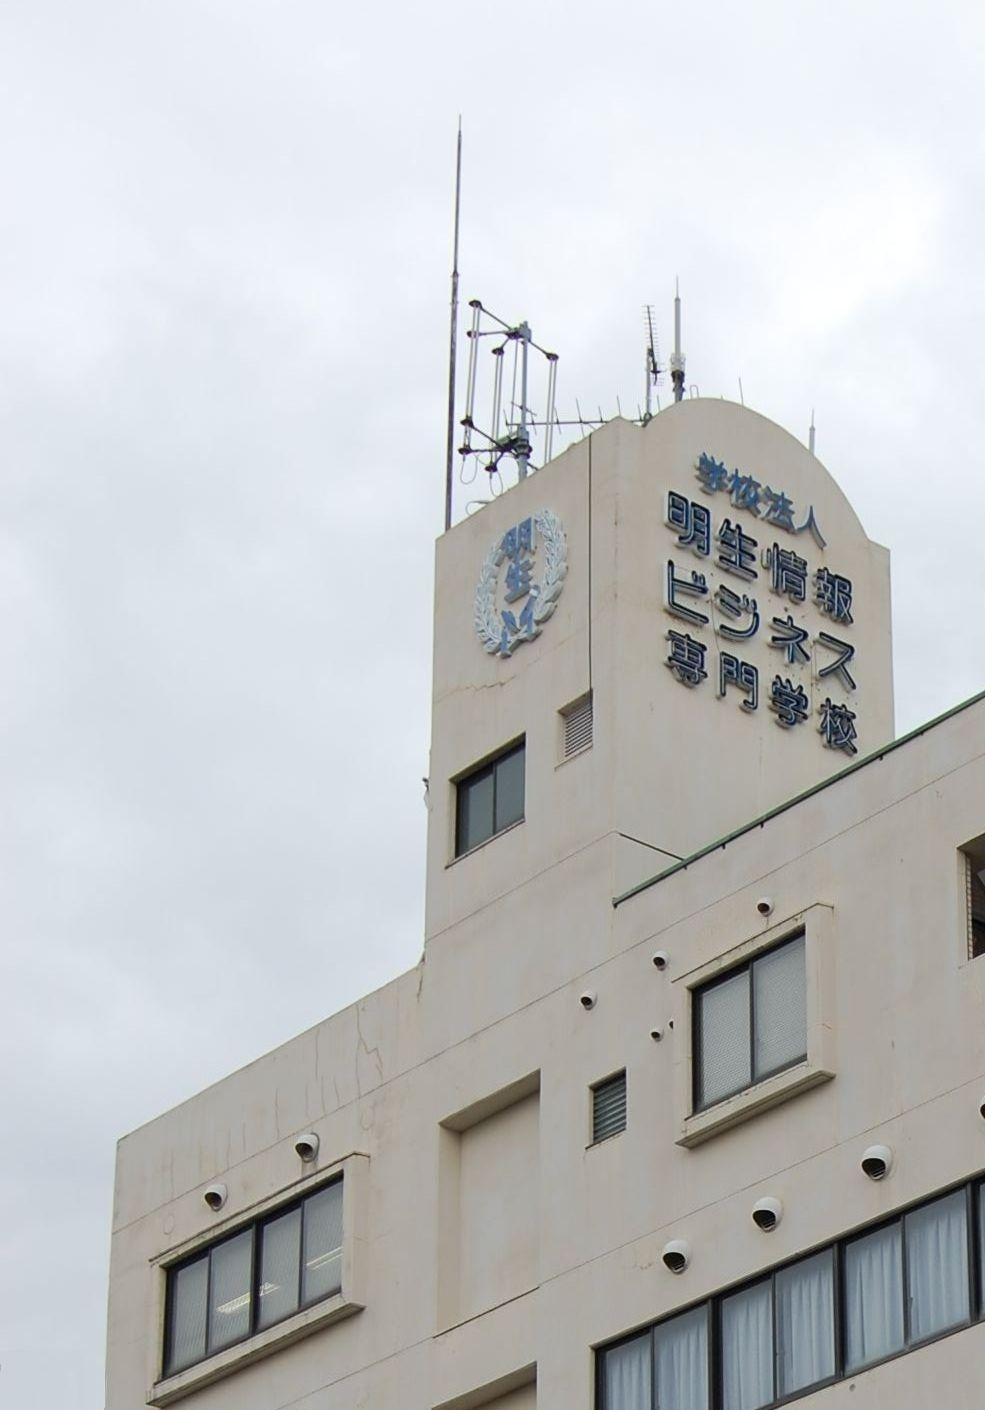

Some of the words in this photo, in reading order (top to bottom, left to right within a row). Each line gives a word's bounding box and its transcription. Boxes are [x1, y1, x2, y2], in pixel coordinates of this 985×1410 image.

[665, 490, 854, 625] 明生情報
[696, 451, 827, 549] 学校法人
[664, 560, 856, 690] ビジネス
[665, 629, 858, 755] 専門学校
